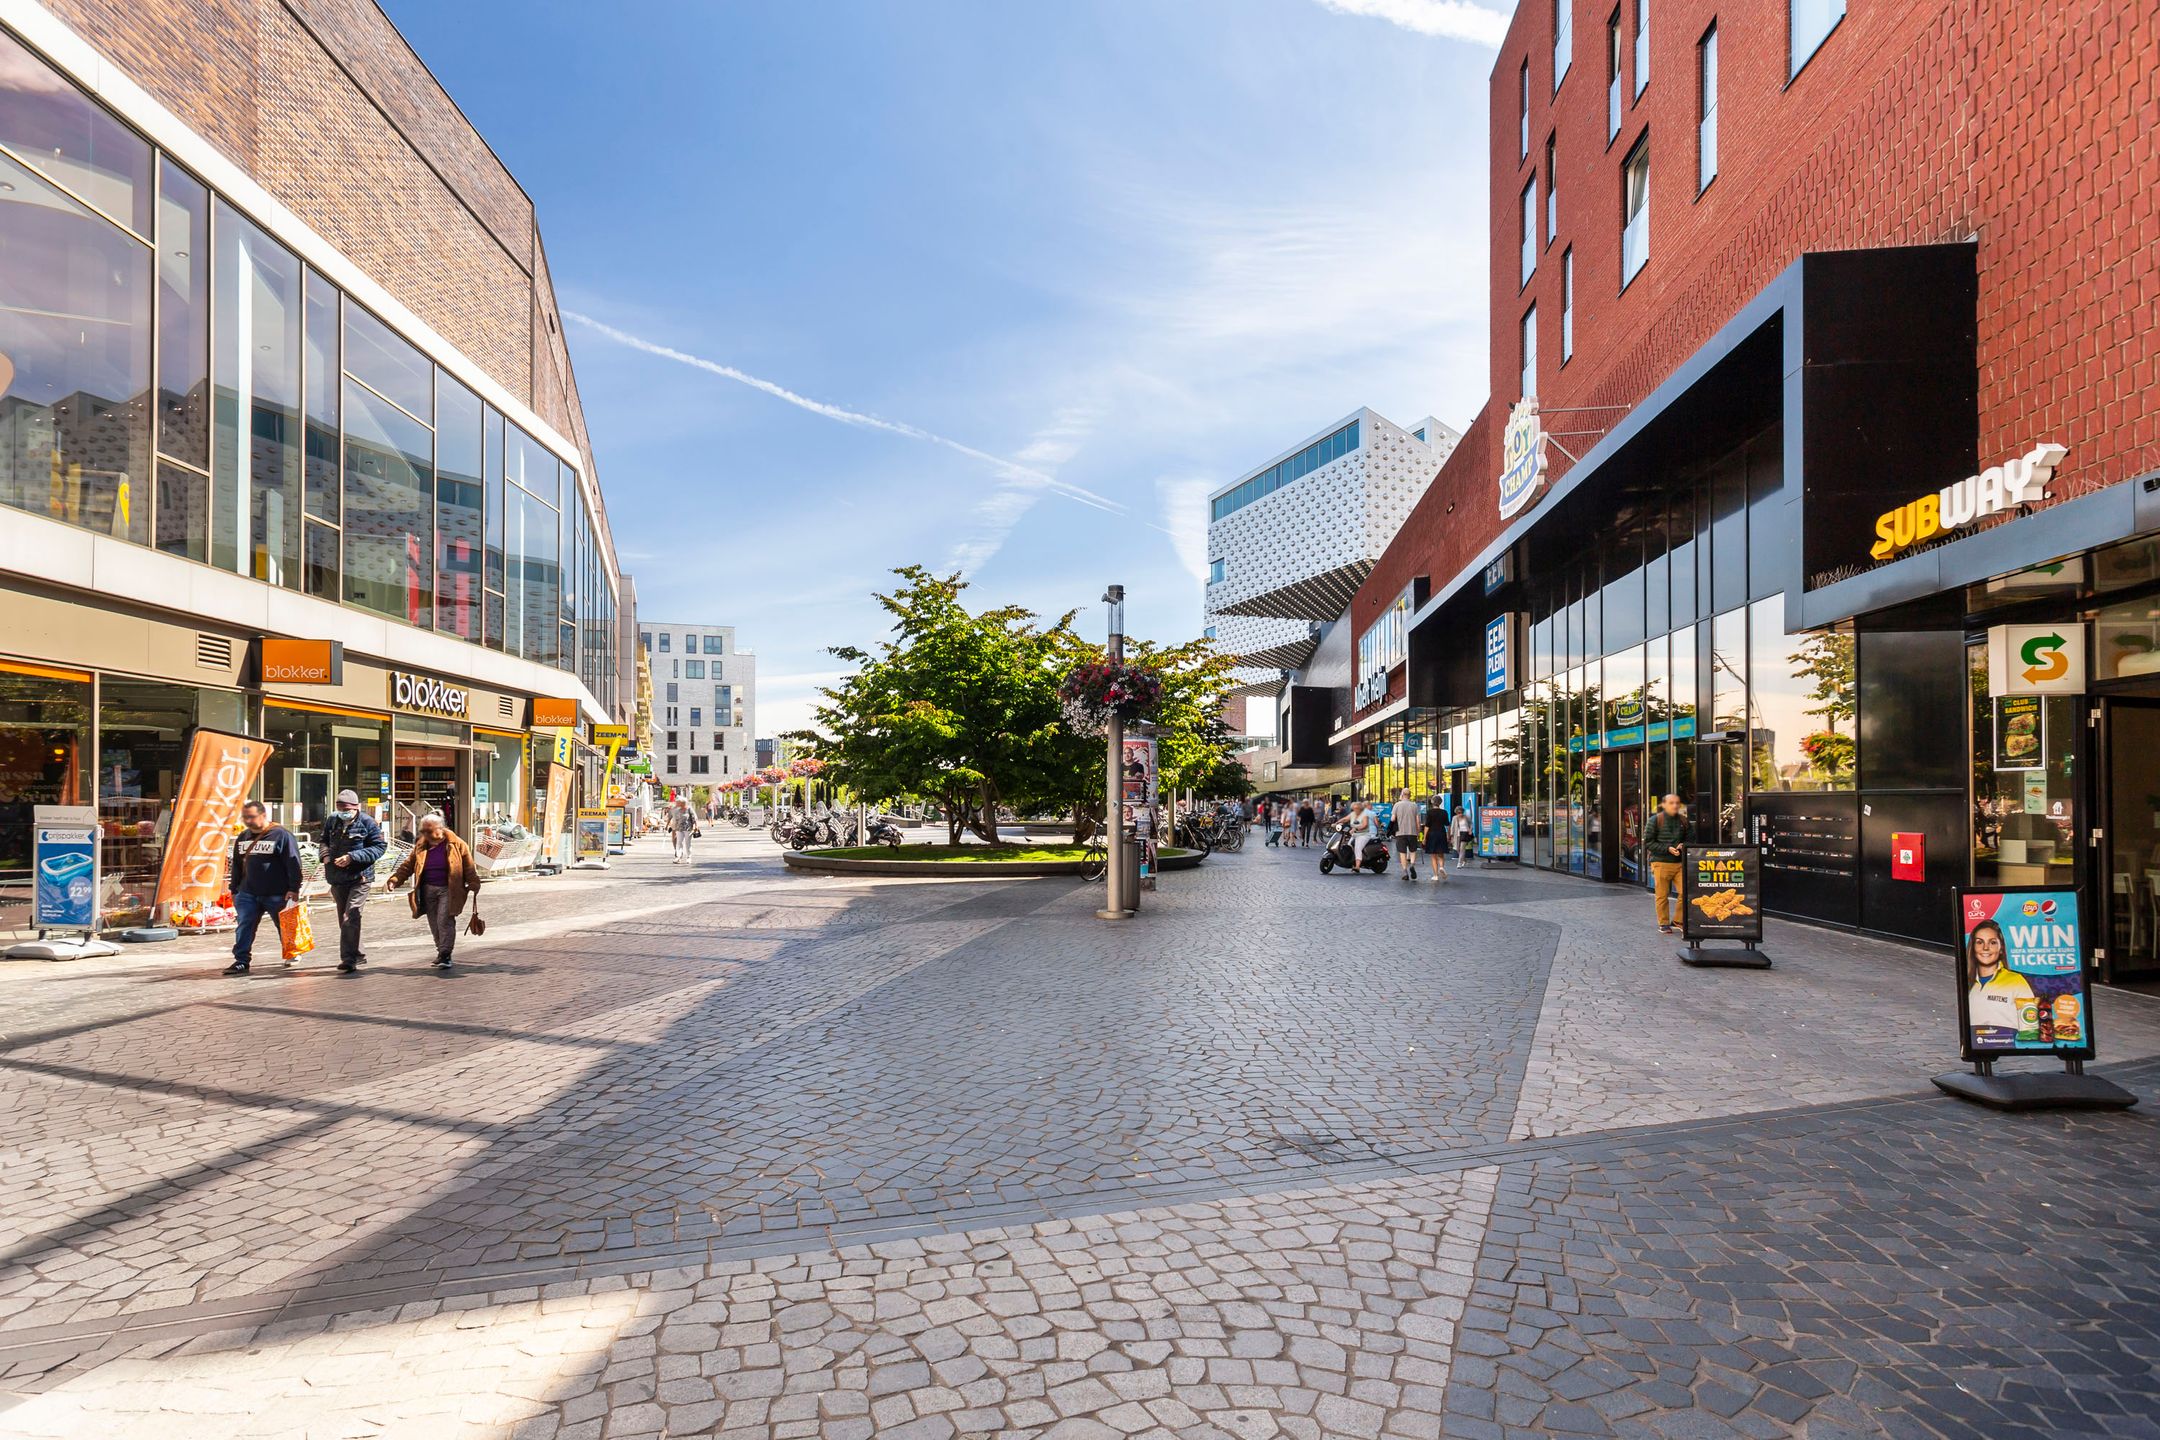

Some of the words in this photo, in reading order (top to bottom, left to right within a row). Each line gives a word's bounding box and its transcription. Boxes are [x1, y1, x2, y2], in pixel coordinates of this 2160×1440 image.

[1504, 424, 1531, 475] TOY
[1504, 454, 1534, 498] CHAMP
[1869, 443, 2069, 561] SUBWAY
[1488, 621, 1504, 656] EEM
[1488, 650, 1504, 675] PLEIN
[1620, 702, 1639, 716] CHAMP
[2005, 704, 2037, 714] SANDWICH
[1713, 872, 1729, 882] IT!
[2009, 925, 2075, 948] WIN
[2011, 953, 2076, 966] TICKETS
[1987, 994, 2008, 1003] MARTENS
